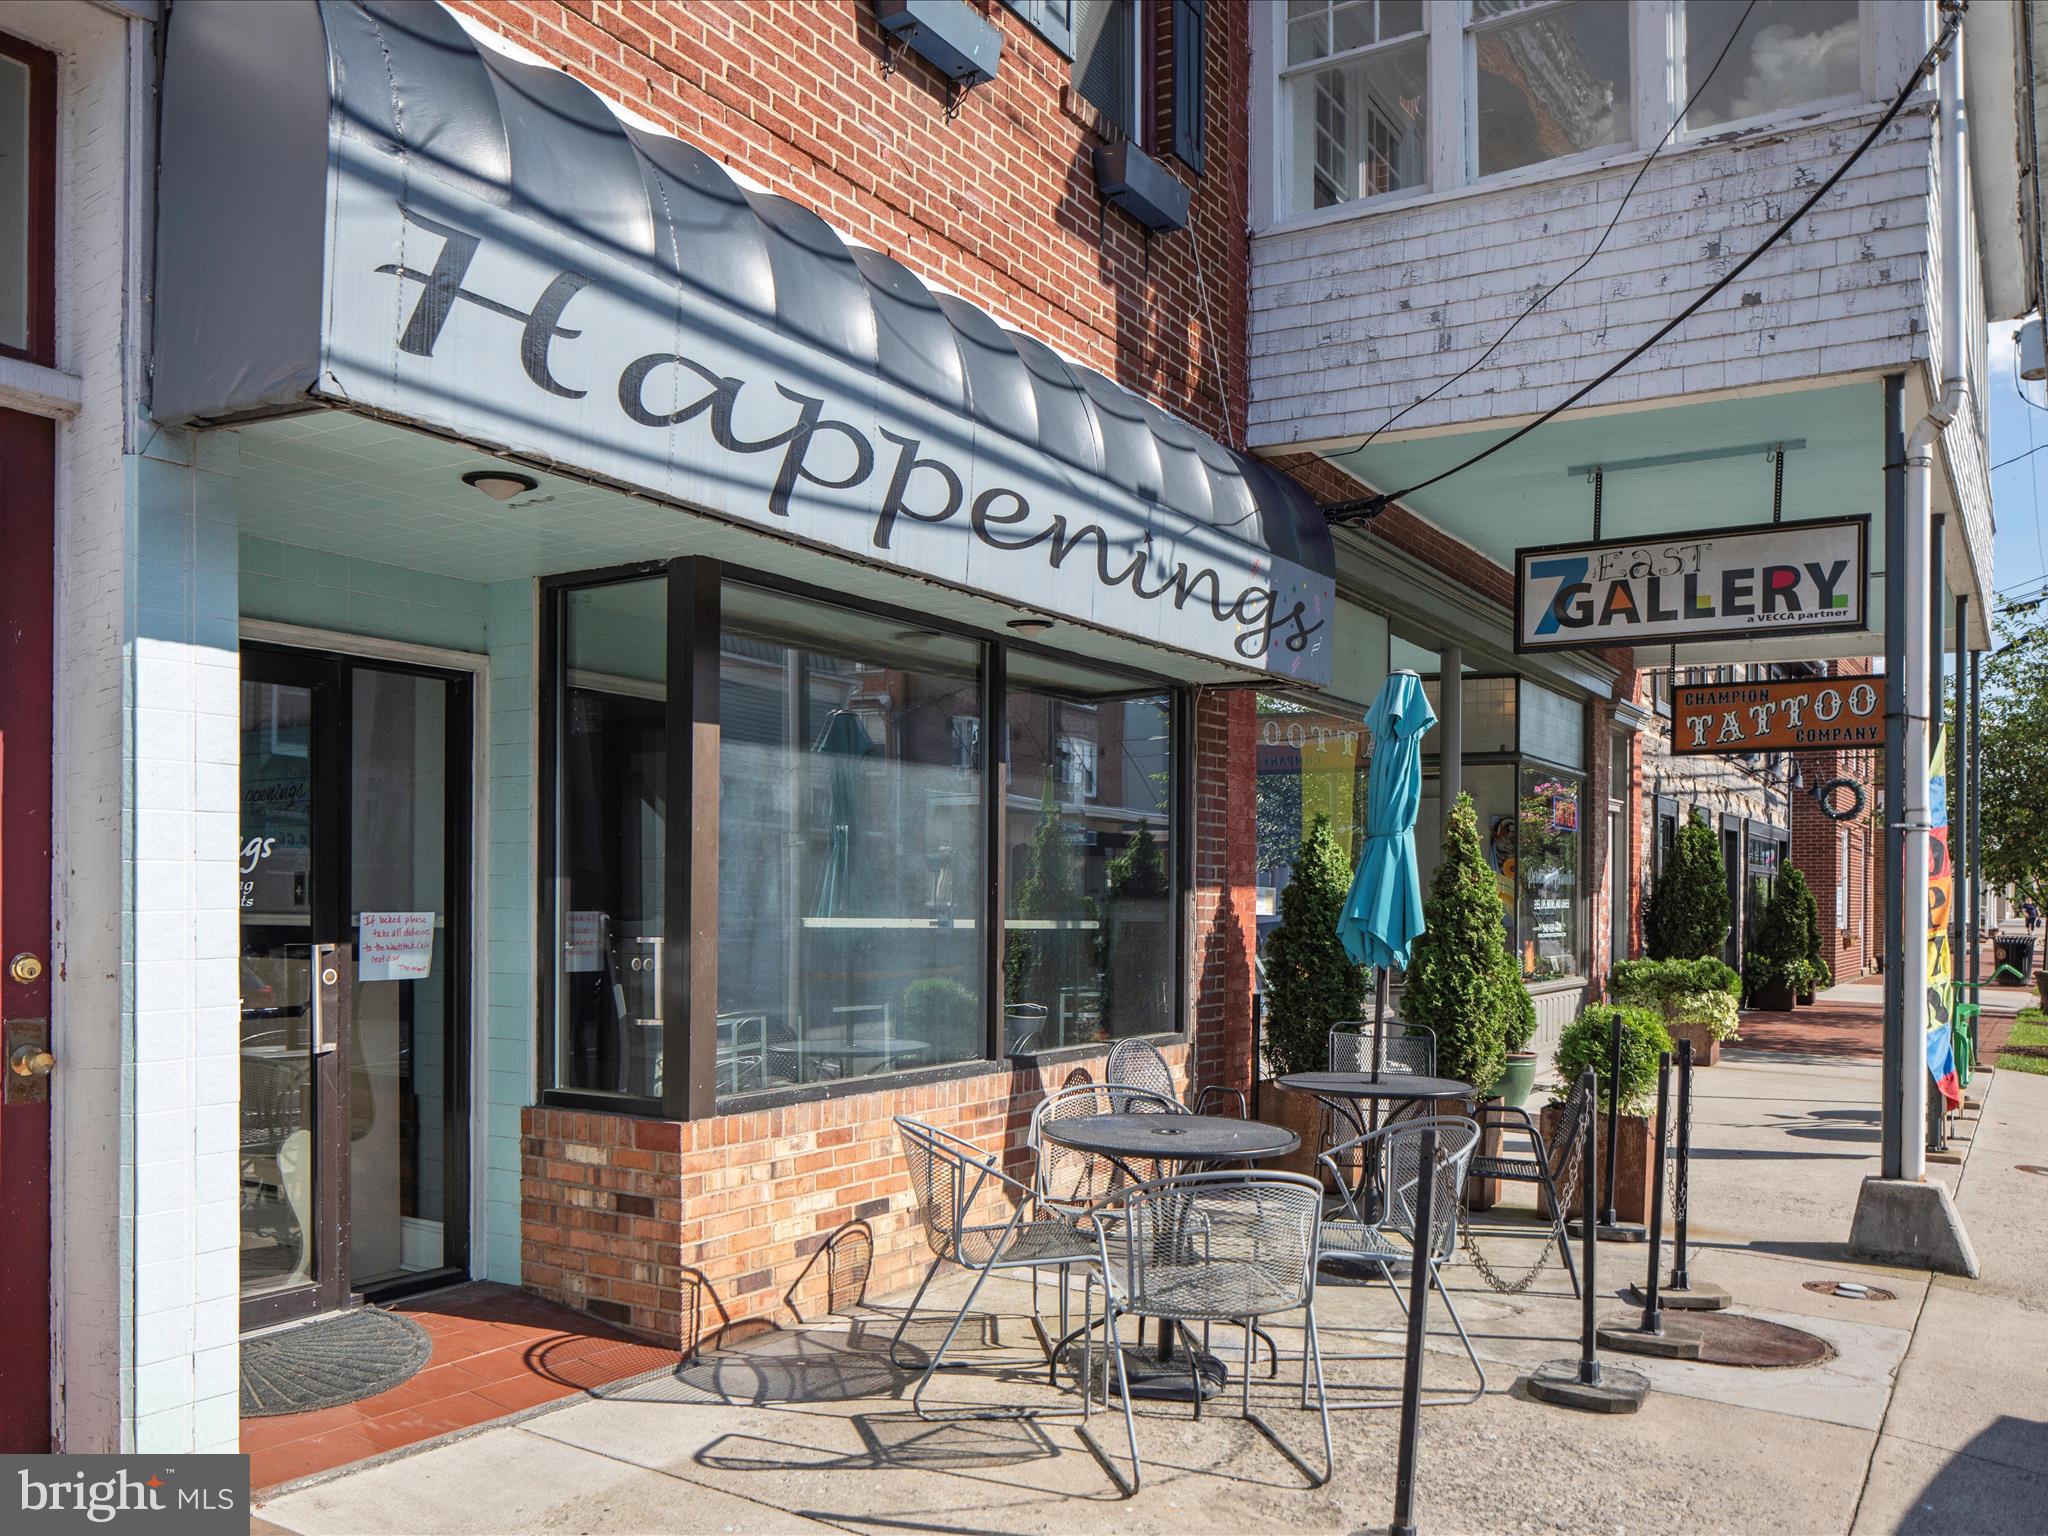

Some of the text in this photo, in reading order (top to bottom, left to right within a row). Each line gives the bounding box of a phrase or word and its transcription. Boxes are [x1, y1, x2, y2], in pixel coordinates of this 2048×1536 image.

[374, 203, 1325, 660] Happenings
[1530, 557, 1589, 635] 7
[1553, 560, 1850, 629] GALLERY
[1758, 609, 1794, 622] VECCA
[1798, 609, 1848, 624] partner
[1685, 690, 1769, 707] CHAMPION
[1686, 684, 1878, 747] TATTOO
[1796, 727, 1878, 743] COMPANY
[364, 915, 375, 926] If
